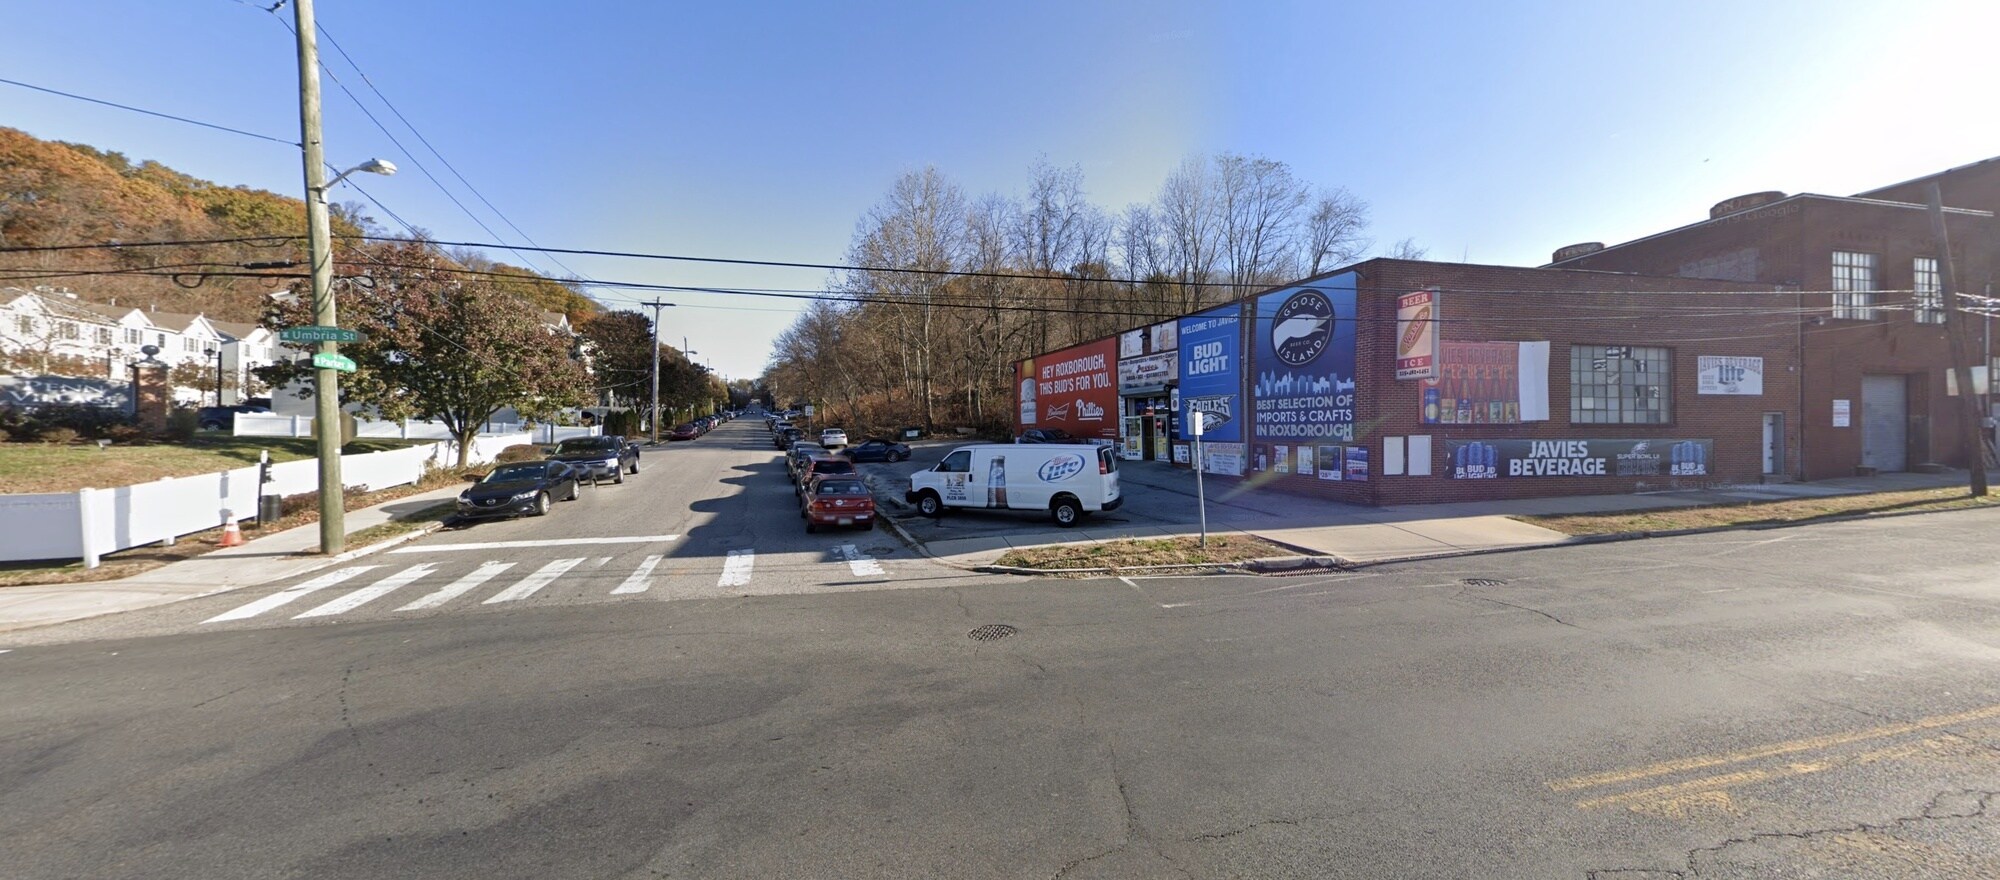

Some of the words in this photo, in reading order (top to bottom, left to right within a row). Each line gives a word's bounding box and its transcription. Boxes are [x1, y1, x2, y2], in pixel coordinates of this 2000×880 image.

[1283, 296, 1323, 317] GOOSE
[1401, 292, 1429, 309] BEER
[292, 331, 337, 340] Umbria
[342, 332, 354, 340] St
[1181, 321, 1208, 335] WELCOME
[1208, 319, 1217, 329] TO
[1193, 341, 1223, 360] BUD
[1280, 339, 1322, 362] ISLAND
[1042, 364, 1055, 379] HEY
[1055, 353, 1107, 377] ROXBOROUGH,
[1188, 355, 1229, 376] LIGHT
[1403, 358, 1424, 368] ICE
[1040, 381, 1053, 396] THIS
[1054, 378, 1074, 394] BUD'S
[1075, 375, 1091, 391] FOR
[1092, 371, 1112, 389] YOU.
[1075, 398, 1104, 421] Phillies
[1188, 396, 1231, 419] EAGLES
[1256, 399, 1276, 411] BEST
[1277, 395, 1334, 410] SELECTION
[1335, 394, 1353, 407] OF
[1256, 411, 1297, 423] IMPORTS
[1299, 410, 1307, 422] &
[1309, 409, 1352, 422] CRAFTS
[1256, 424, 1267, 437] IN
[1269, 423, 1353, 437] ROXBOROUGH
[1528, 440, 1588, 458] JAVIES
[1509, 458, 1606, 476] BEVERAGE
